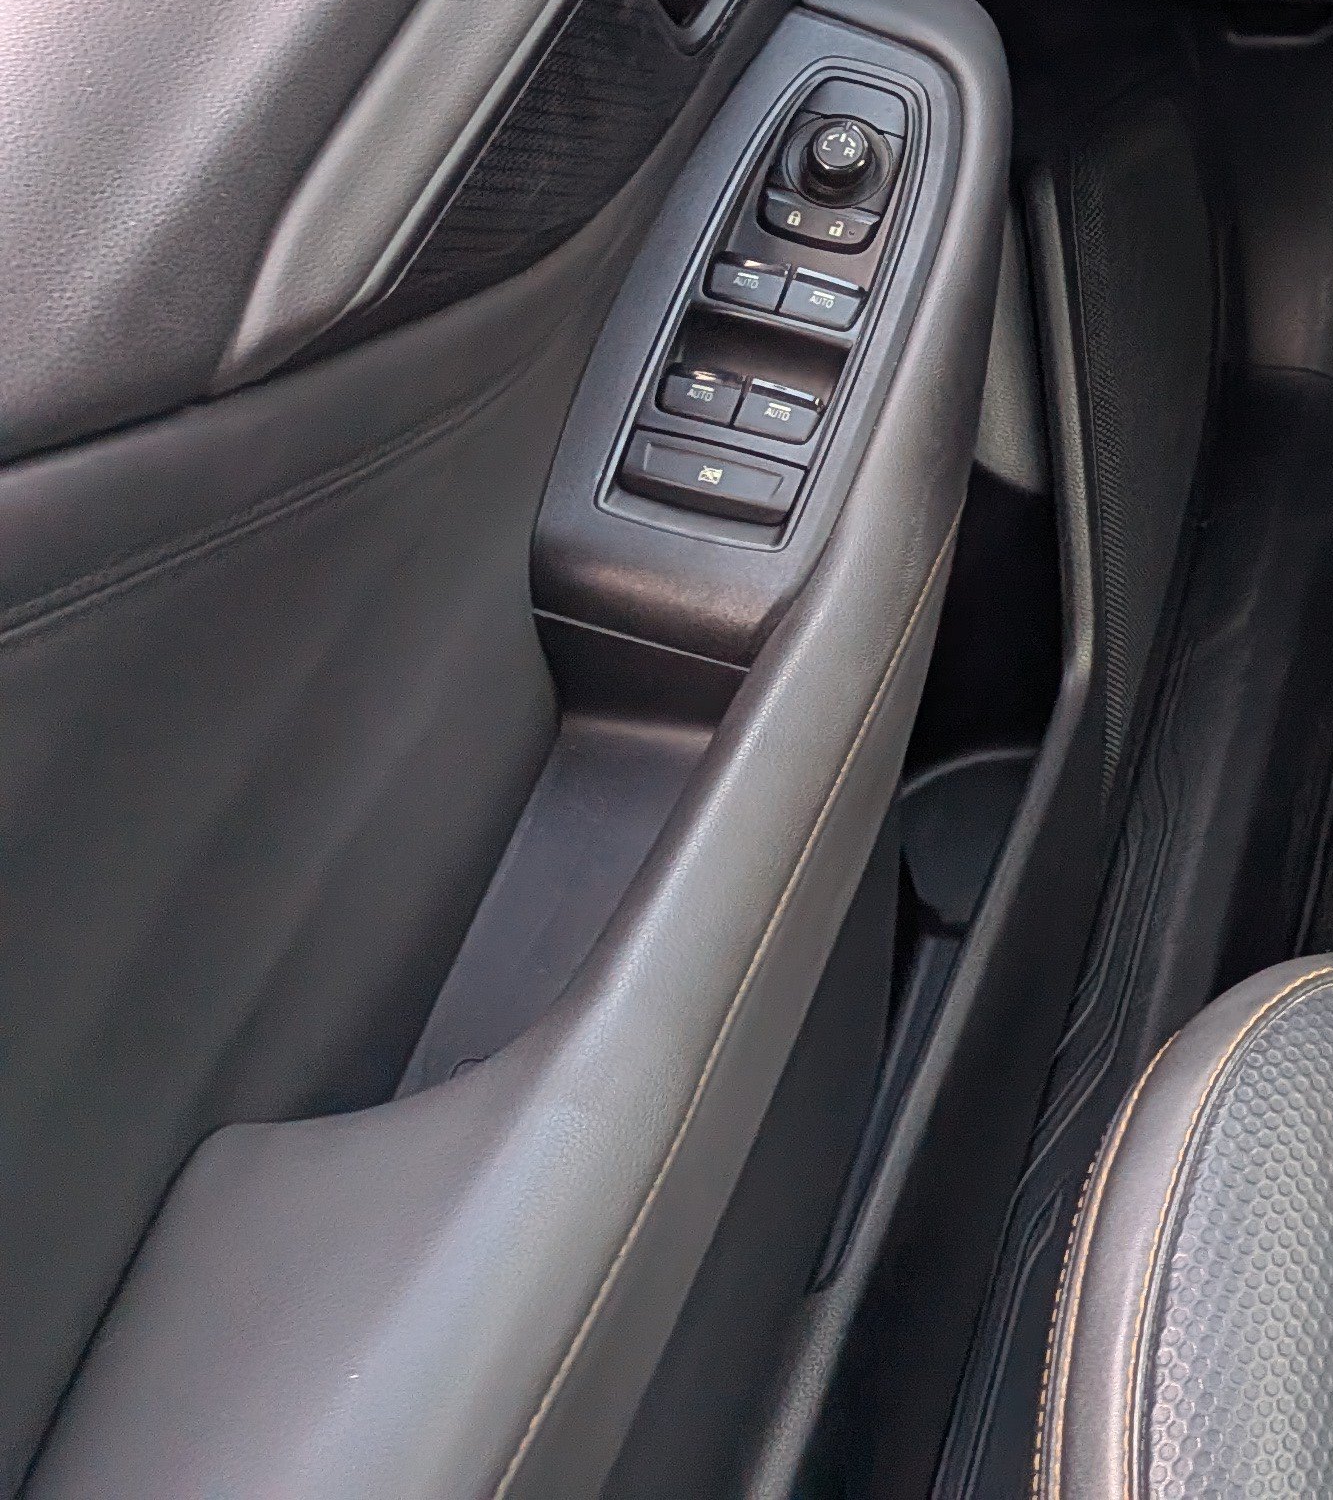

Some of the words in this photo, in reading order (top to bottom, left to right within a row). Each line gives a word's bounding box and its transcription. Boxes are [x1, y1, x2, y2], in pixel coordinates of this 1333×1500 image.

[843, 146, 856, 158] R
[733, 276, 759, 290] AUTO
[809, 295, 835, 309] AUTO
[687, 387, 713, 401] AUTO
[764, 407, 791, 422] AUTO
